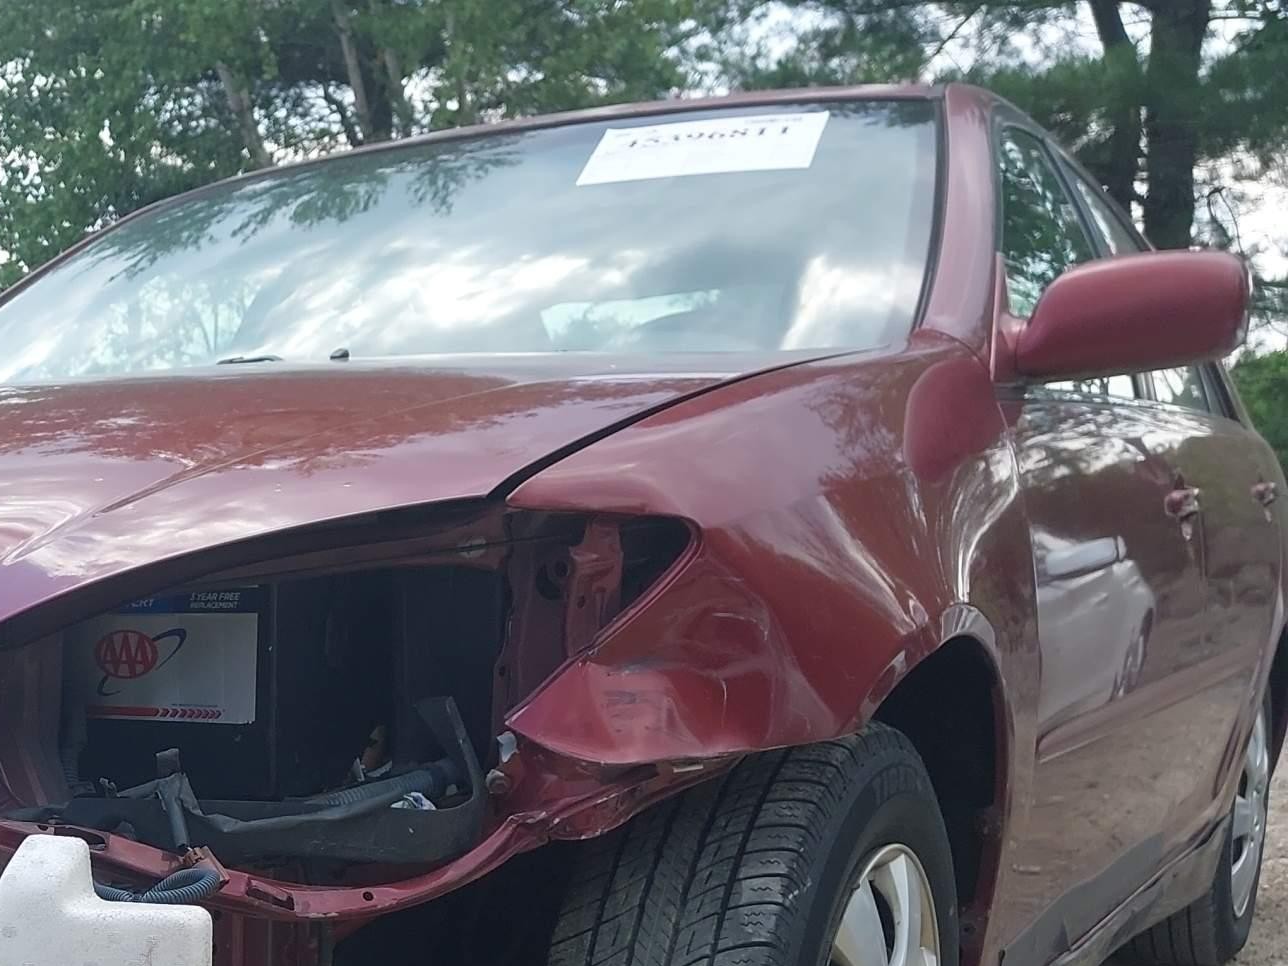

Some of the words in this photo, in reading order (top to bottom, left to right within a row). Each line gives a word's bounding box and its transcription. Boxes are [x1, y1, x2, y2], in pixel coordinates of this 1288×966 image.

[196, 592, 218, 601] YEAR
[218, 592, 241, 601] FREE
[99, 632, 154, 679] AAA
